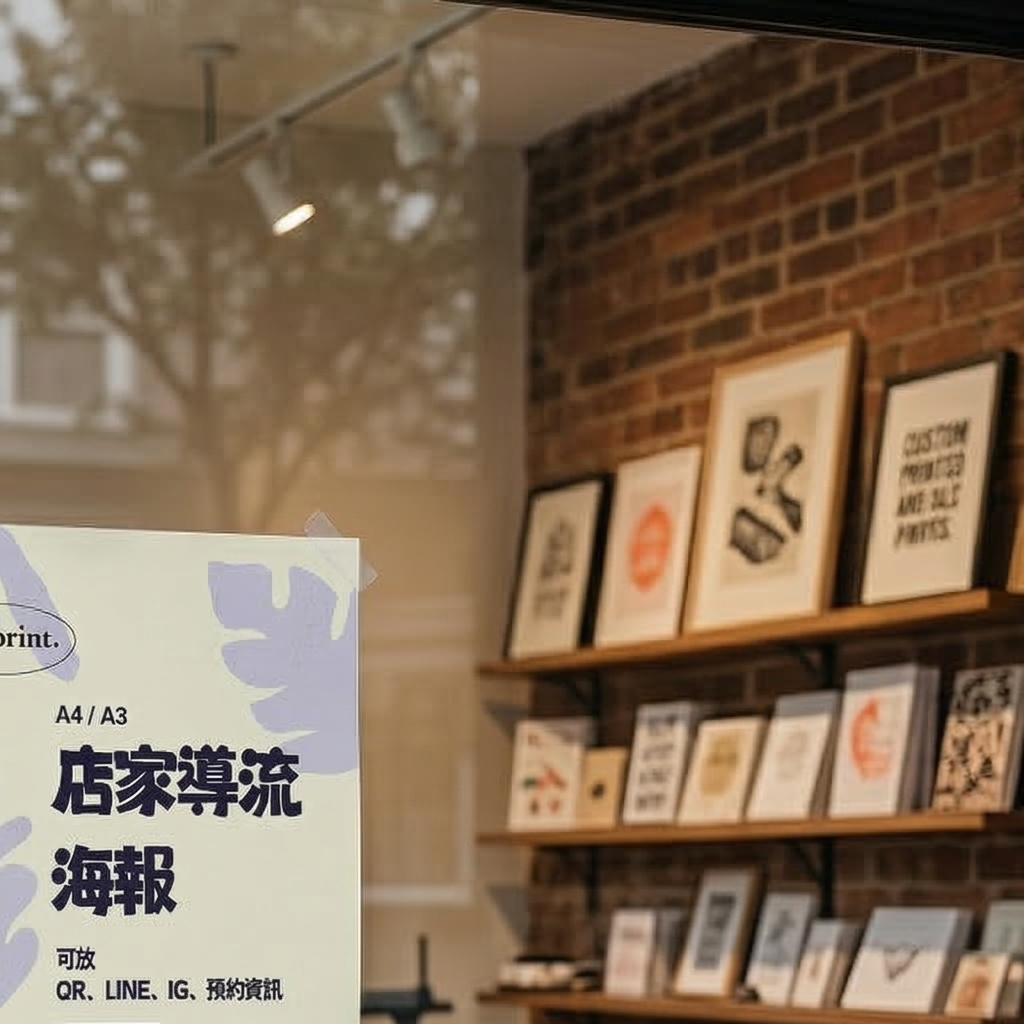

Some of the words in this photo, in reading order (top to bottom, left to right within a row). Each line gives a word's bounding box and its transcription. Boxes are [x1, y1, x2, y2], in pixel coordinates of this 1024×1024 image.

[55, 705, 83, 724] A4
[100, 706, 128, 725] A3
[51, 744, 303, 818] 店家導流
[51, 844, 178, 917] 海報
[56, 946, 96, 971] 可放
